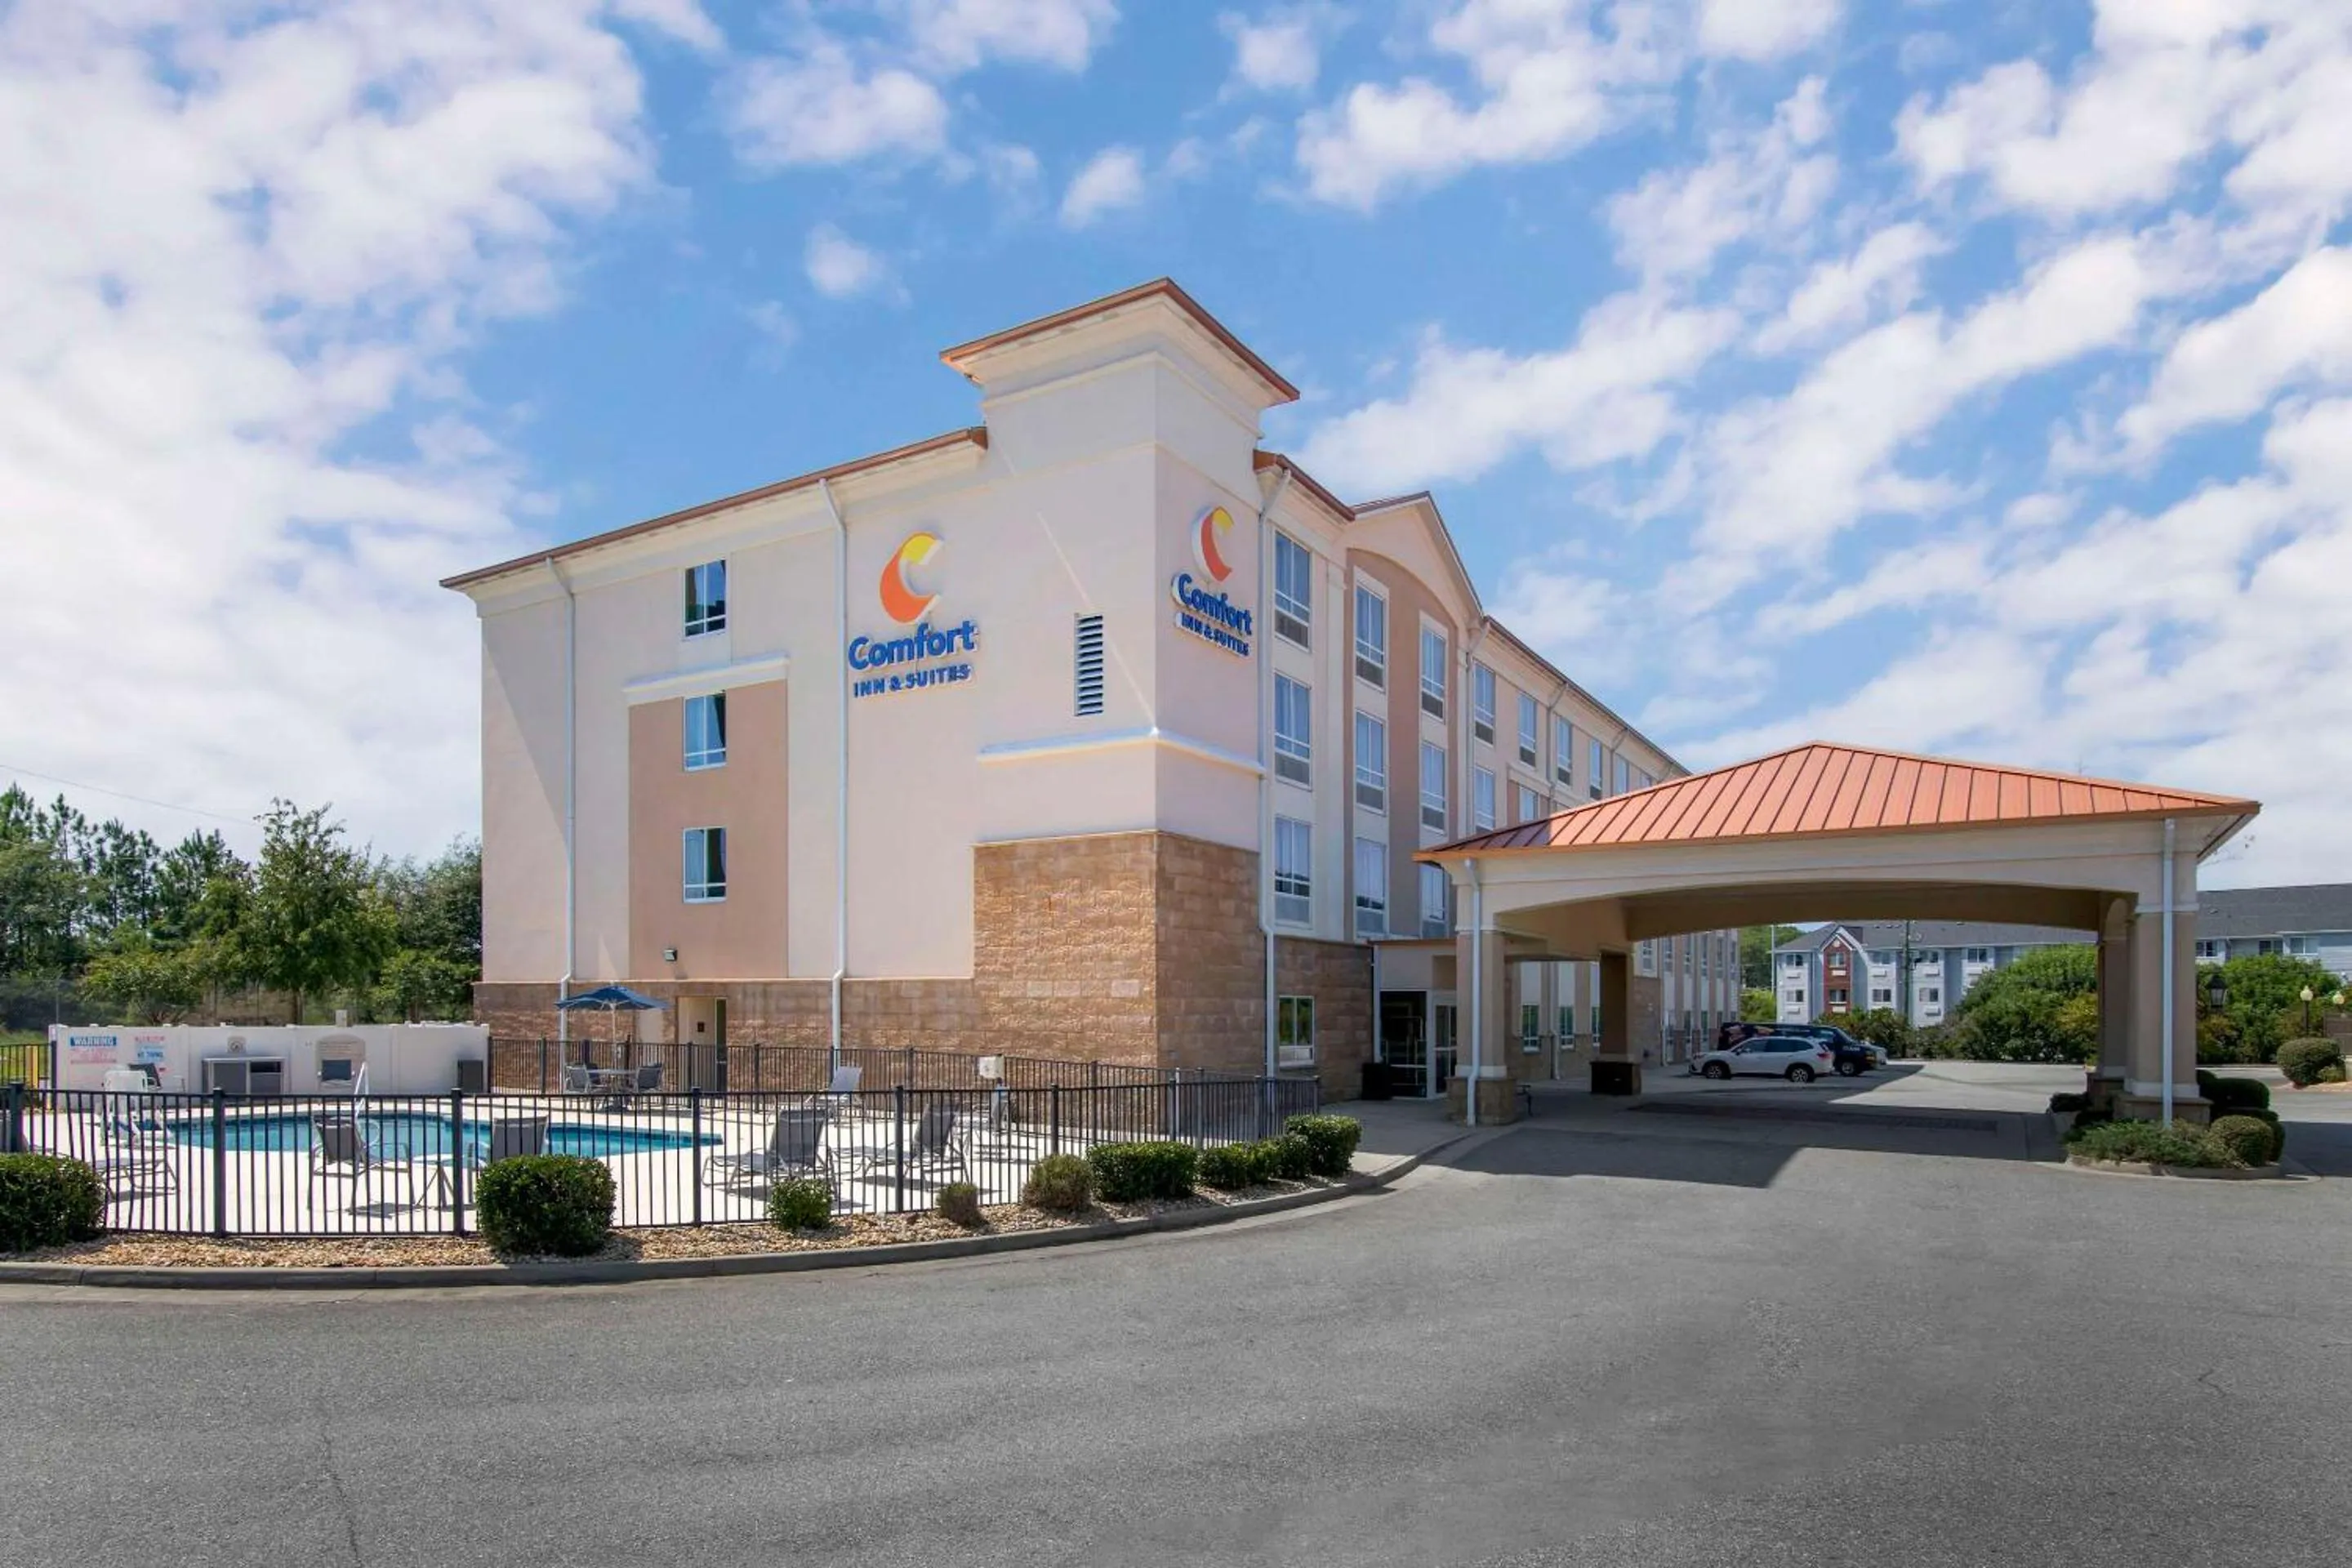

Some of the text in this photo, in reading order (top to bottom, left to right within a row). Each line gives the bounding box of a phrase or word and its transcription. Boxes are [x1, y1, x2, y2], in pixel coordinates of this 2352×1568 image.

[1178, 572, 1251, 635] Comfort
[849, 621, 975, 670] Comfort
[1181, 612, 1203, 635] INN
[1214, 629, 1250, 656] SUITES
[853, 664, 971, 697] INN & SUITES
[74, 1036, 114, 1046] WARNING
